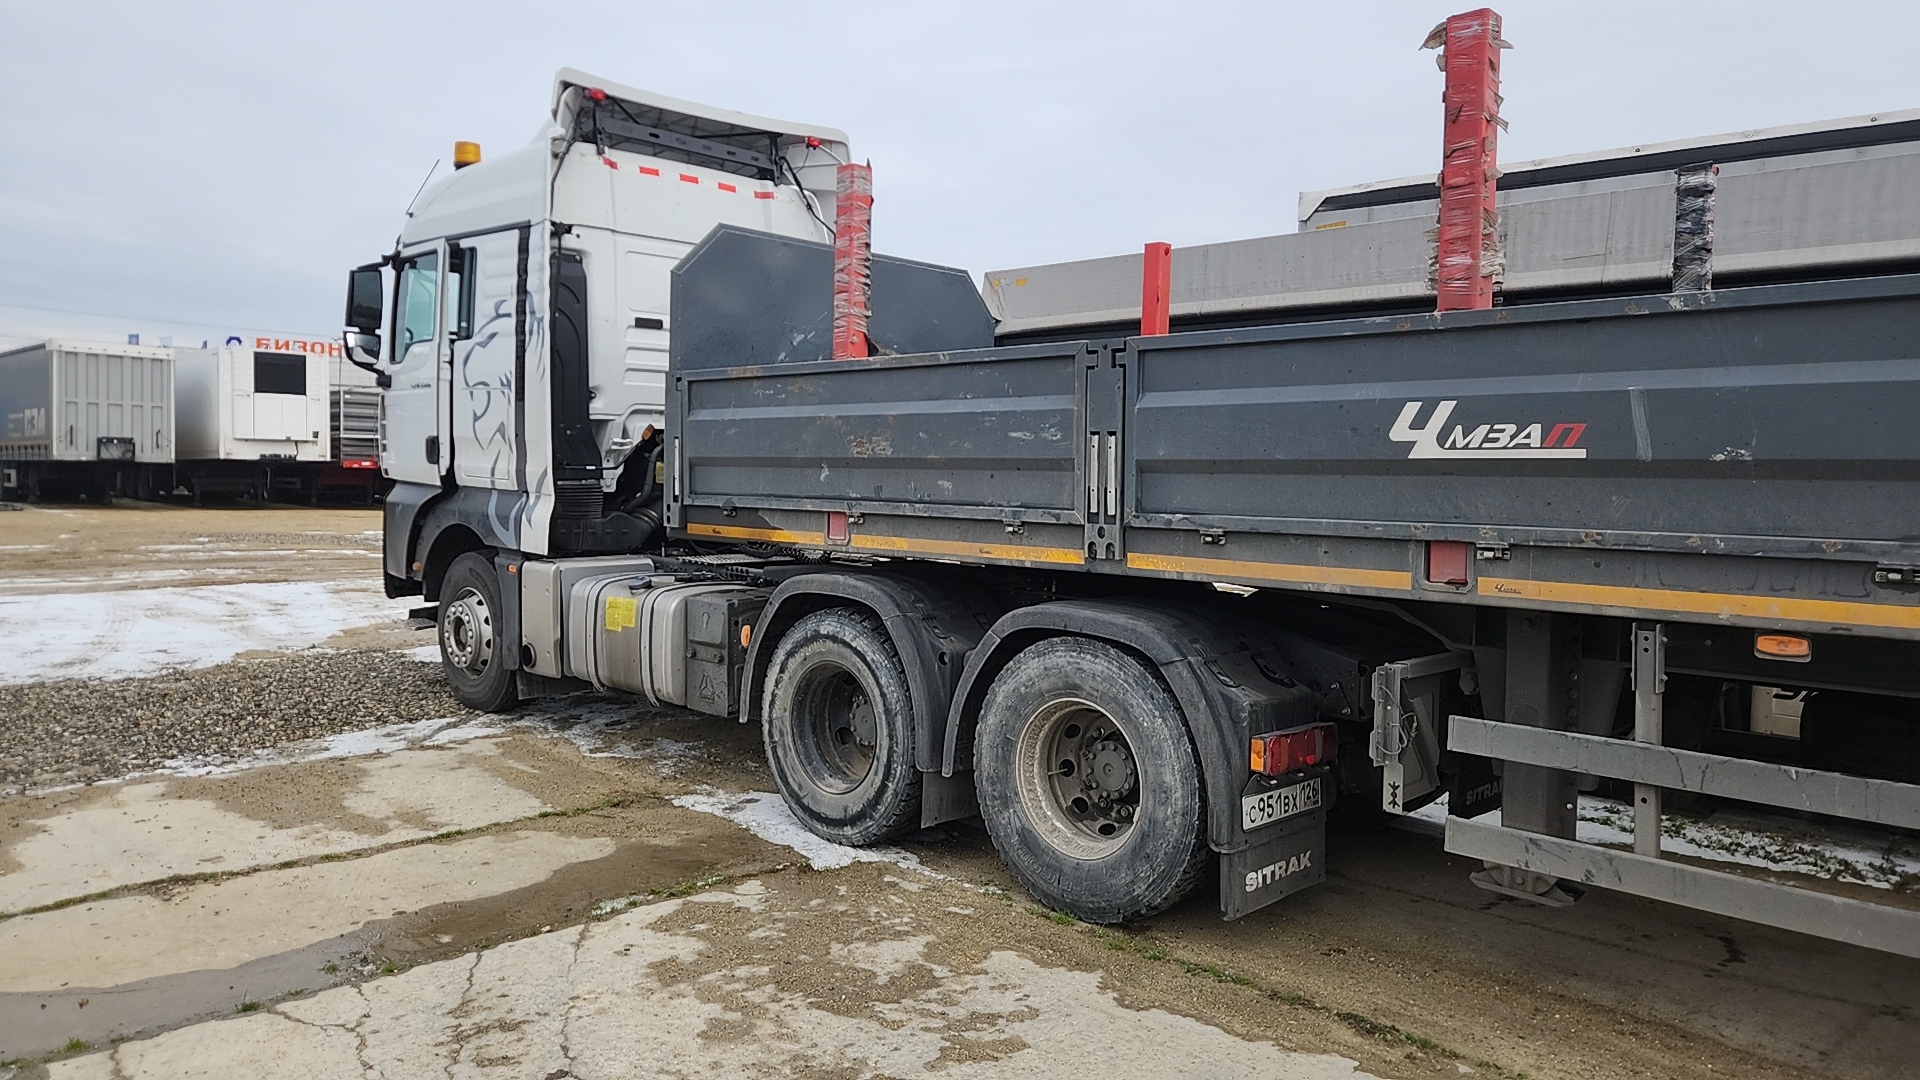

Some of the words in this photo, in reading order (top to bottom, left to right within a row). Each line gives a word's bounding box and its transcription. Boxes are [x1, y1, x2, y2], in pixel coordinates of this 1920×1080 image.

[255, 336, 343, 358] БИЗОН
[1388, 400, 1587, 459] ЧМЗАП
[1245, 849, 1312, 893] SITRAK
